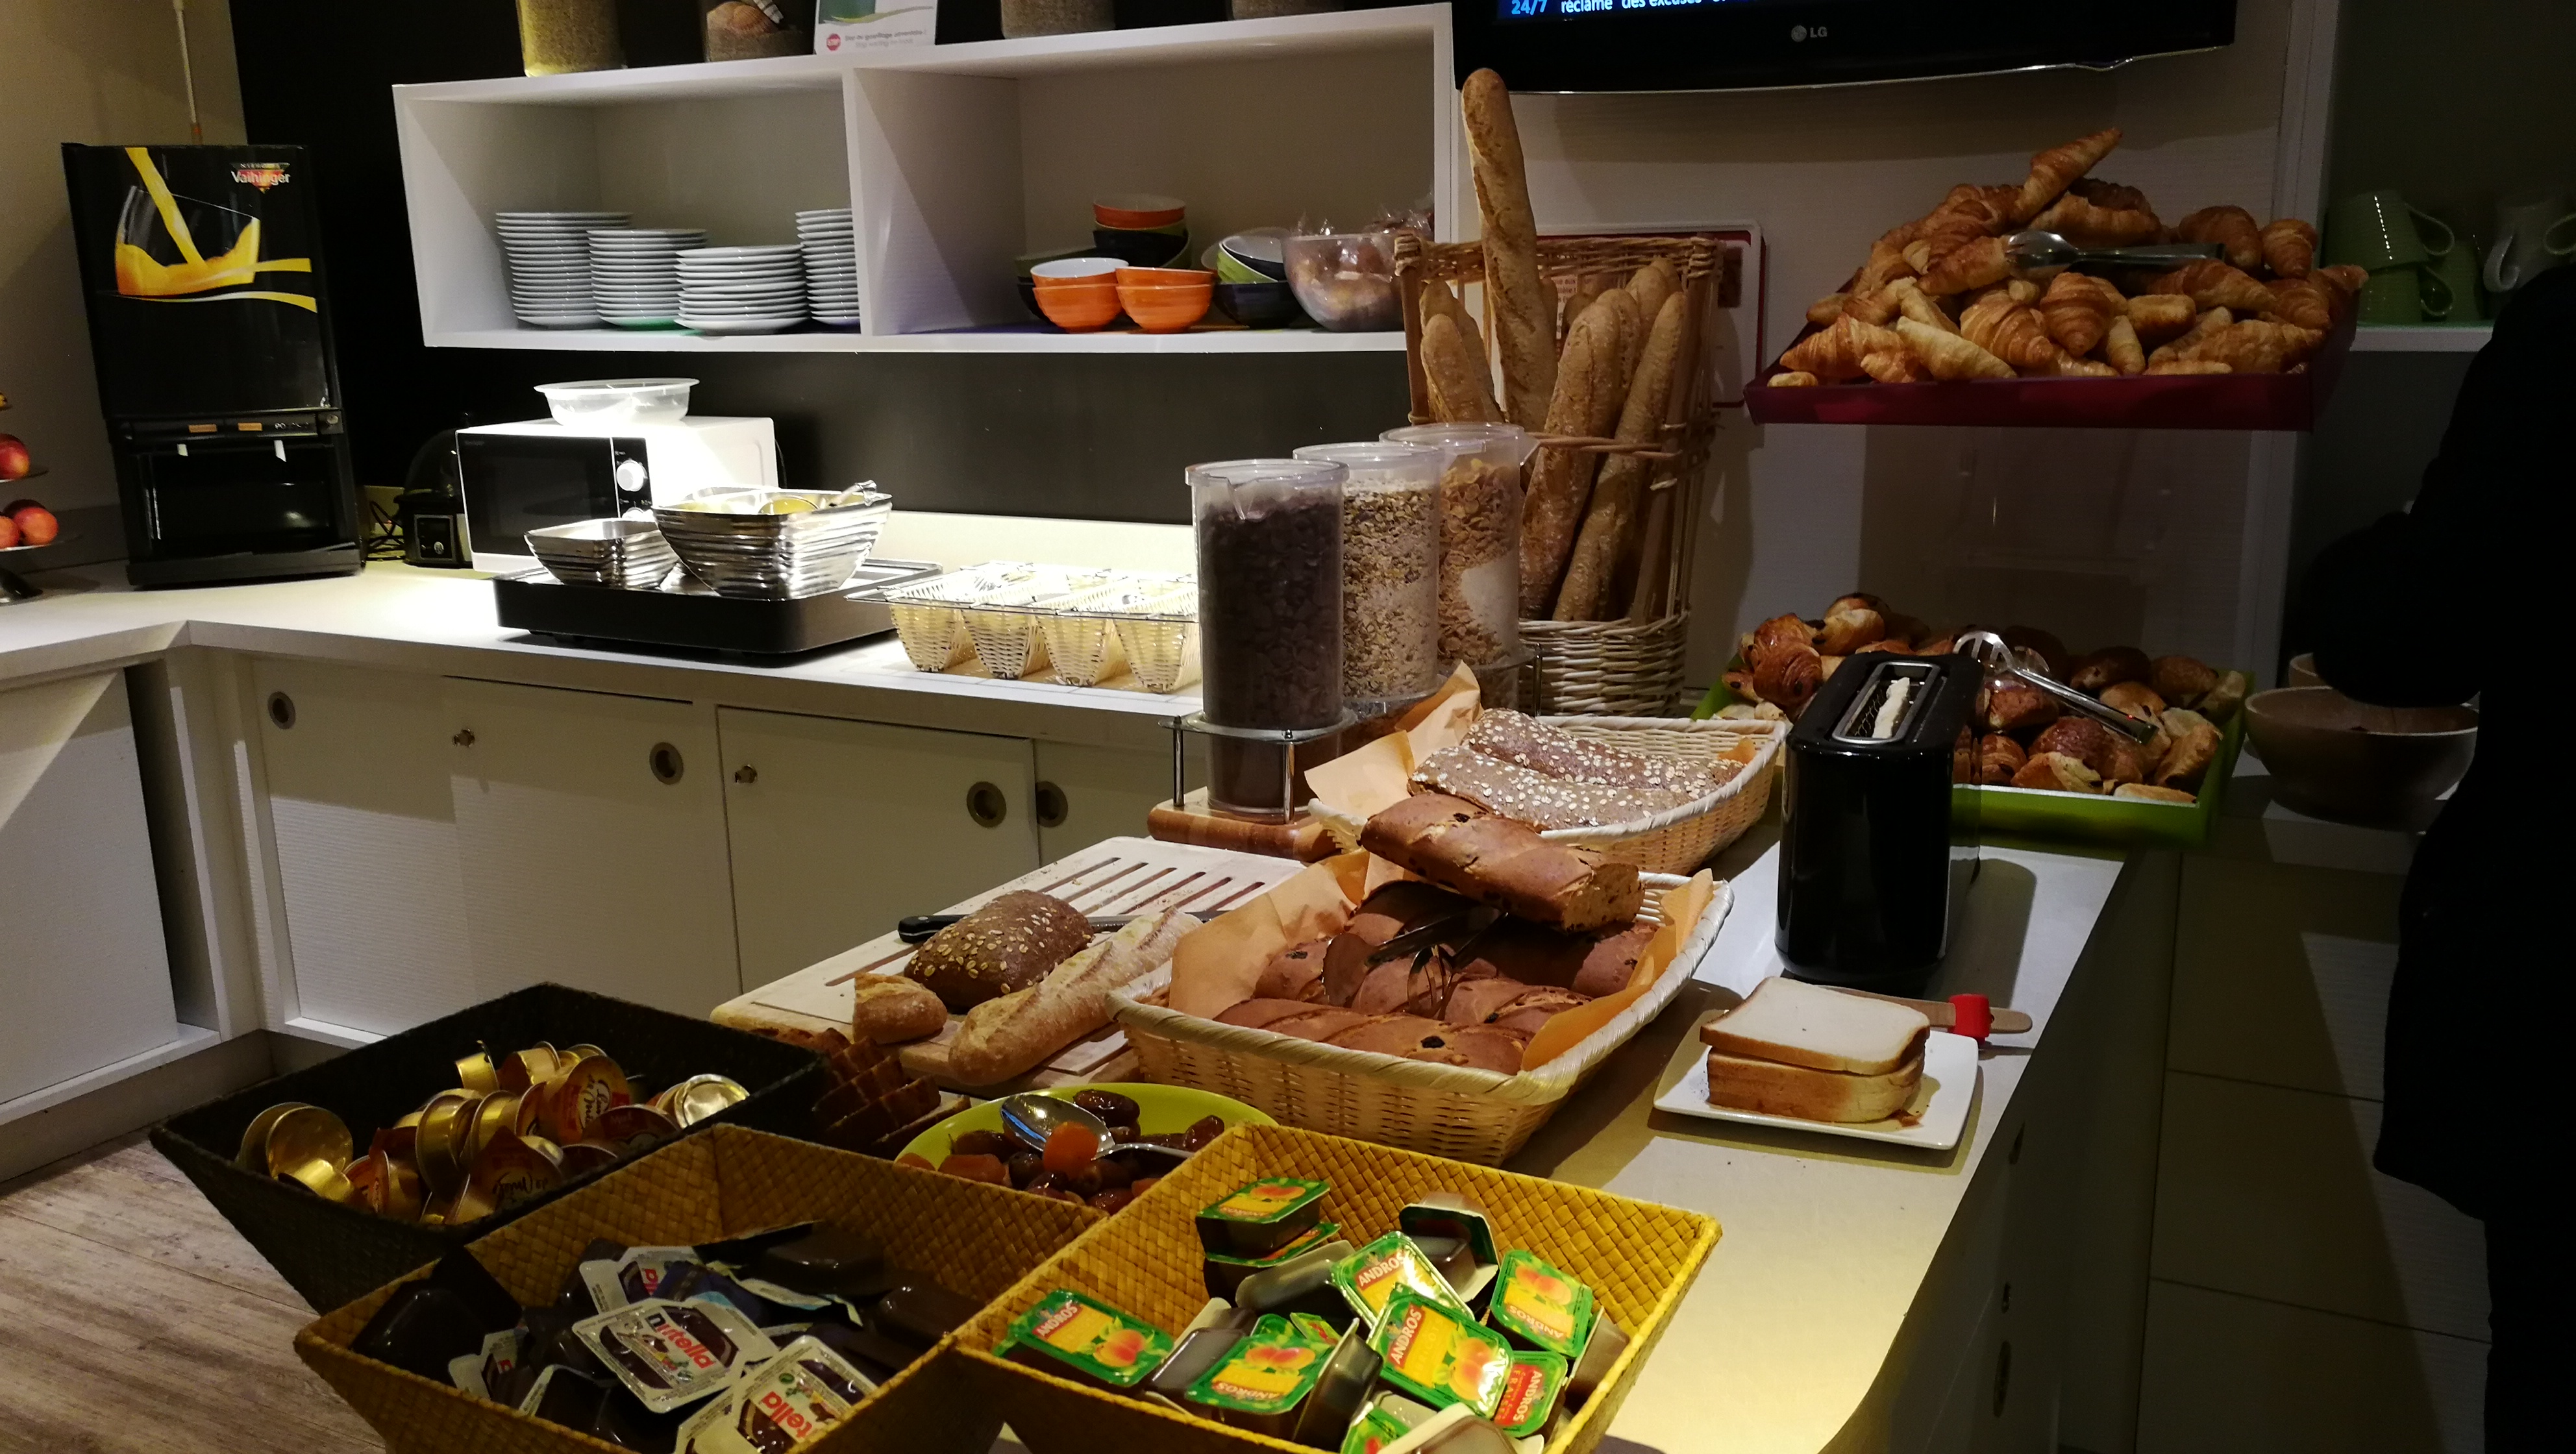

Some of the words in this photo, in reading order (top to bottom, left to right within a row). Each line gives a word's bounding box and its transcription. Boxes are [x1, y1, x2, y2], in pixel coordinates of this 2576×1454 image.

[1511, 0, 1547, 16] 24/7
[1810, 27, 1827, 38] LG
[1357, 1251, 1405, 1287] ANDROS
[1037, 1300, 1078, 1337] ANDROS
[1391, 1308, 1422, 1364] ANDROS
[1510, 1305, 1564, 1338] ANDROS
[645, 1312, 714, 1369] nutella
[760, 1391, 812, 1438] tella
[1513, 1370, 1542, 1422] ANDROS
